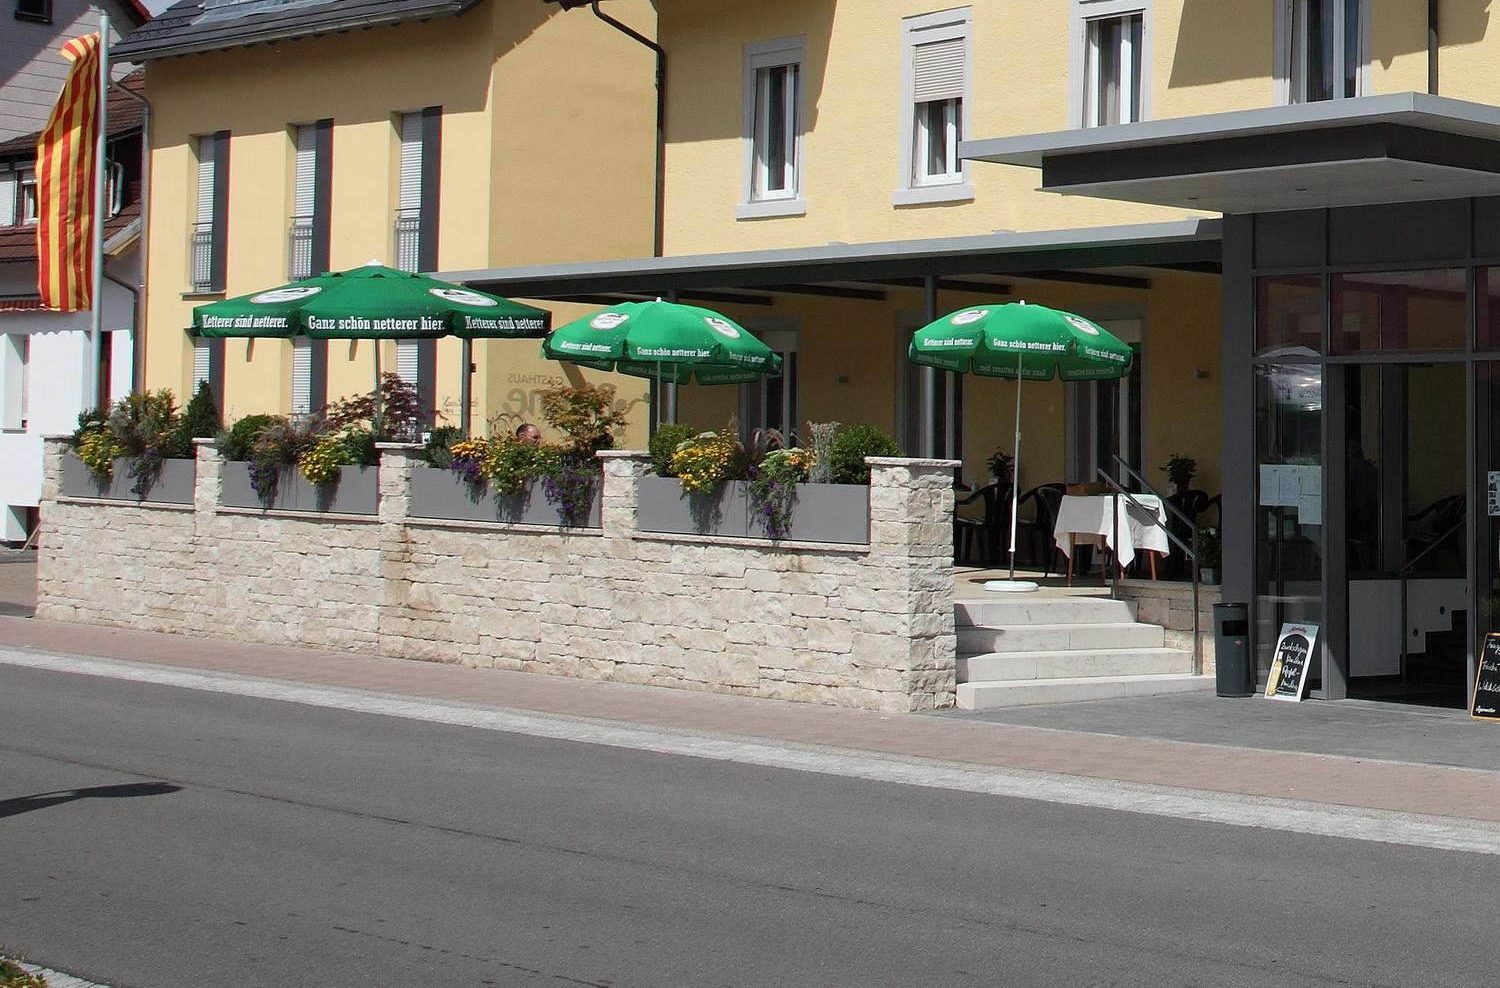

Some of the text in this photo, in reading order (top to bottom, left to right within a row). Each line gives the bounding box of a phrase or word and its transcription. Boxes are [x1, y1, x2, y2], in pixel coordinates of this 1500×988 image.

[202, 314, 289, 328] Ketterer sind netterer.
[308, 315, 446, 331] Ganz schön netterer hier.
[465, 315, 497, 329] Ketterer
[498, 316, 515, 330] sind
[993, 338, 1008, 347] Ganz
[637, 346, 652, 356] Ganz
